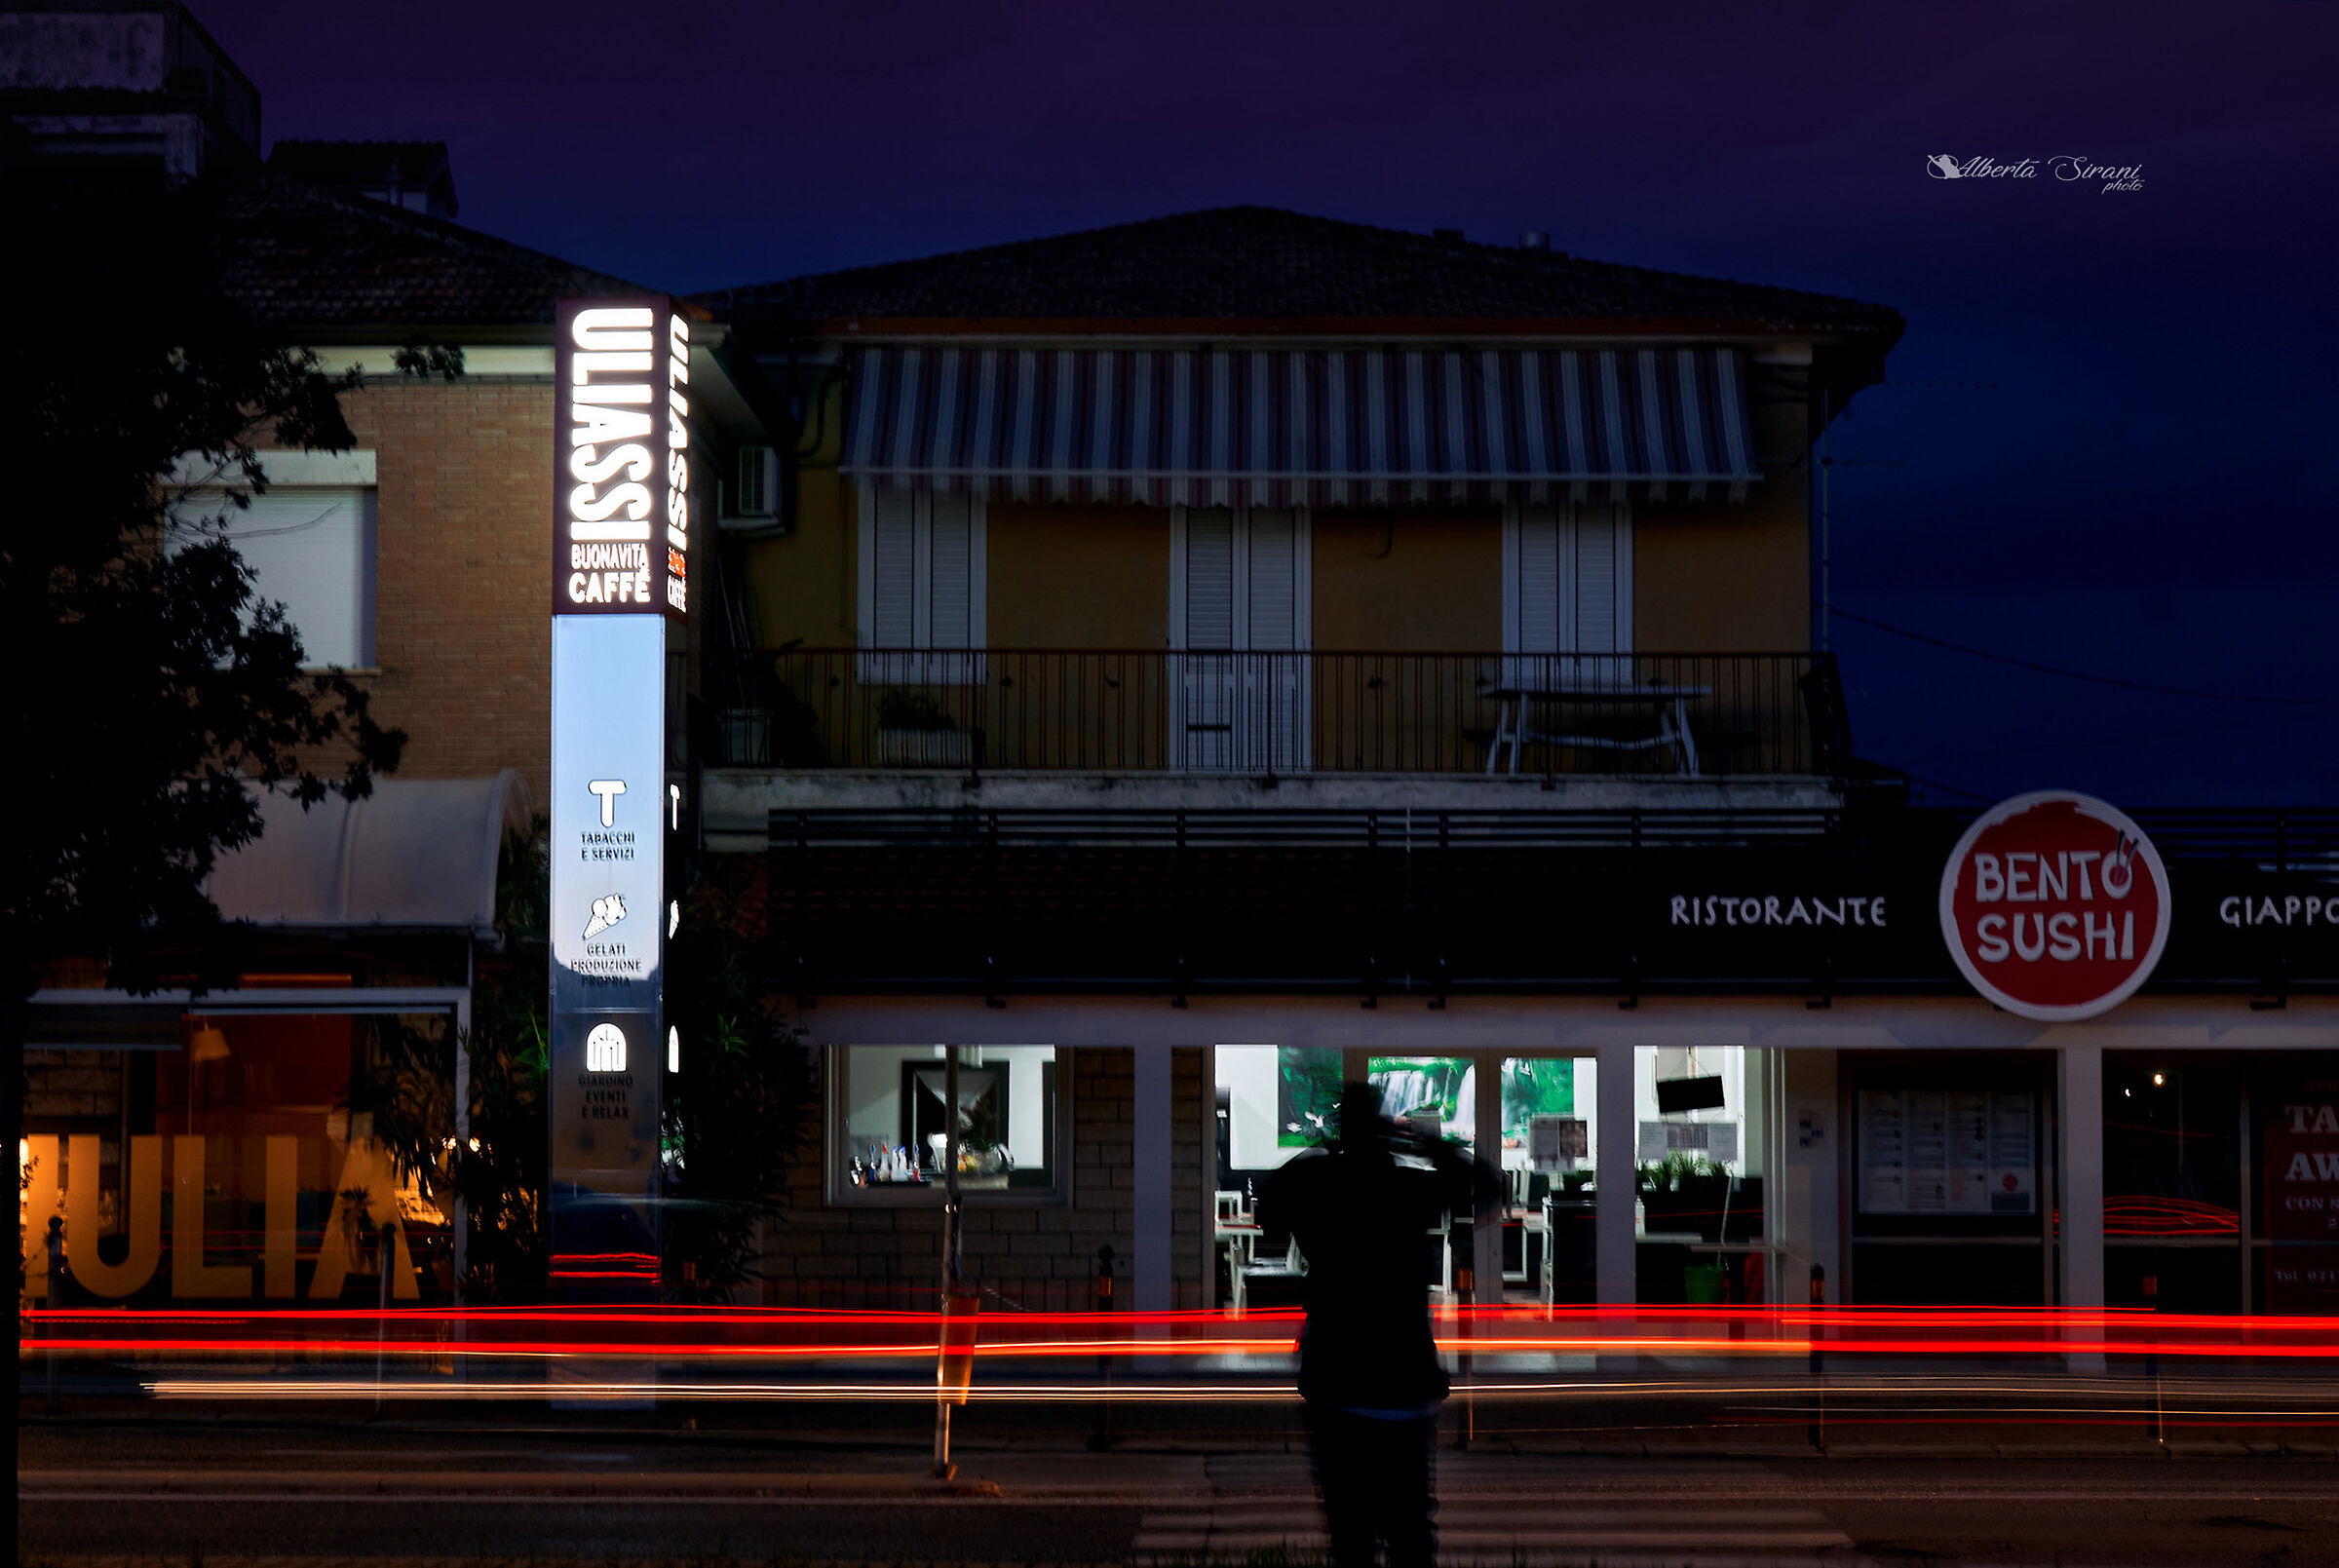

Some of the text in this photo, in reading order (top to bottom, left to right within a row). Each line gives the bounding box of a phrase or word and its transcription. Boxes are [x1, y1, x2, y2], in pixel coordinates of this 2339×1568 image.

[570, 308, 653, 541] ULIASSI
[668, 313, 689, 552] ULIASSI
[571, 544, 650, 569] BUONAVITA
[581, 831, 635, 846] TABACCHI
[581, 847, 635, 860] E SERVIZI
[1975, 851, 2134, 902] BENTO
[1670, 895, 1887, 927] RISTORANTE
[2219, 895, 2339, 927] GIAPPO
[1976, 910, 2135, 962] SUSHI
[587, 943, 627, 957] GELATI
[570, 959, 642, 973] PRODUZIONE
[582, 975, 632, 988] PROPRIA
[578, 1073, 633, 1088] GIARDINO
[586, 1090, 627, 1103] EVENTI
[581, 1105, 630, 1119] E RELAX
[2285, 1195, 2324, 1210] CON
